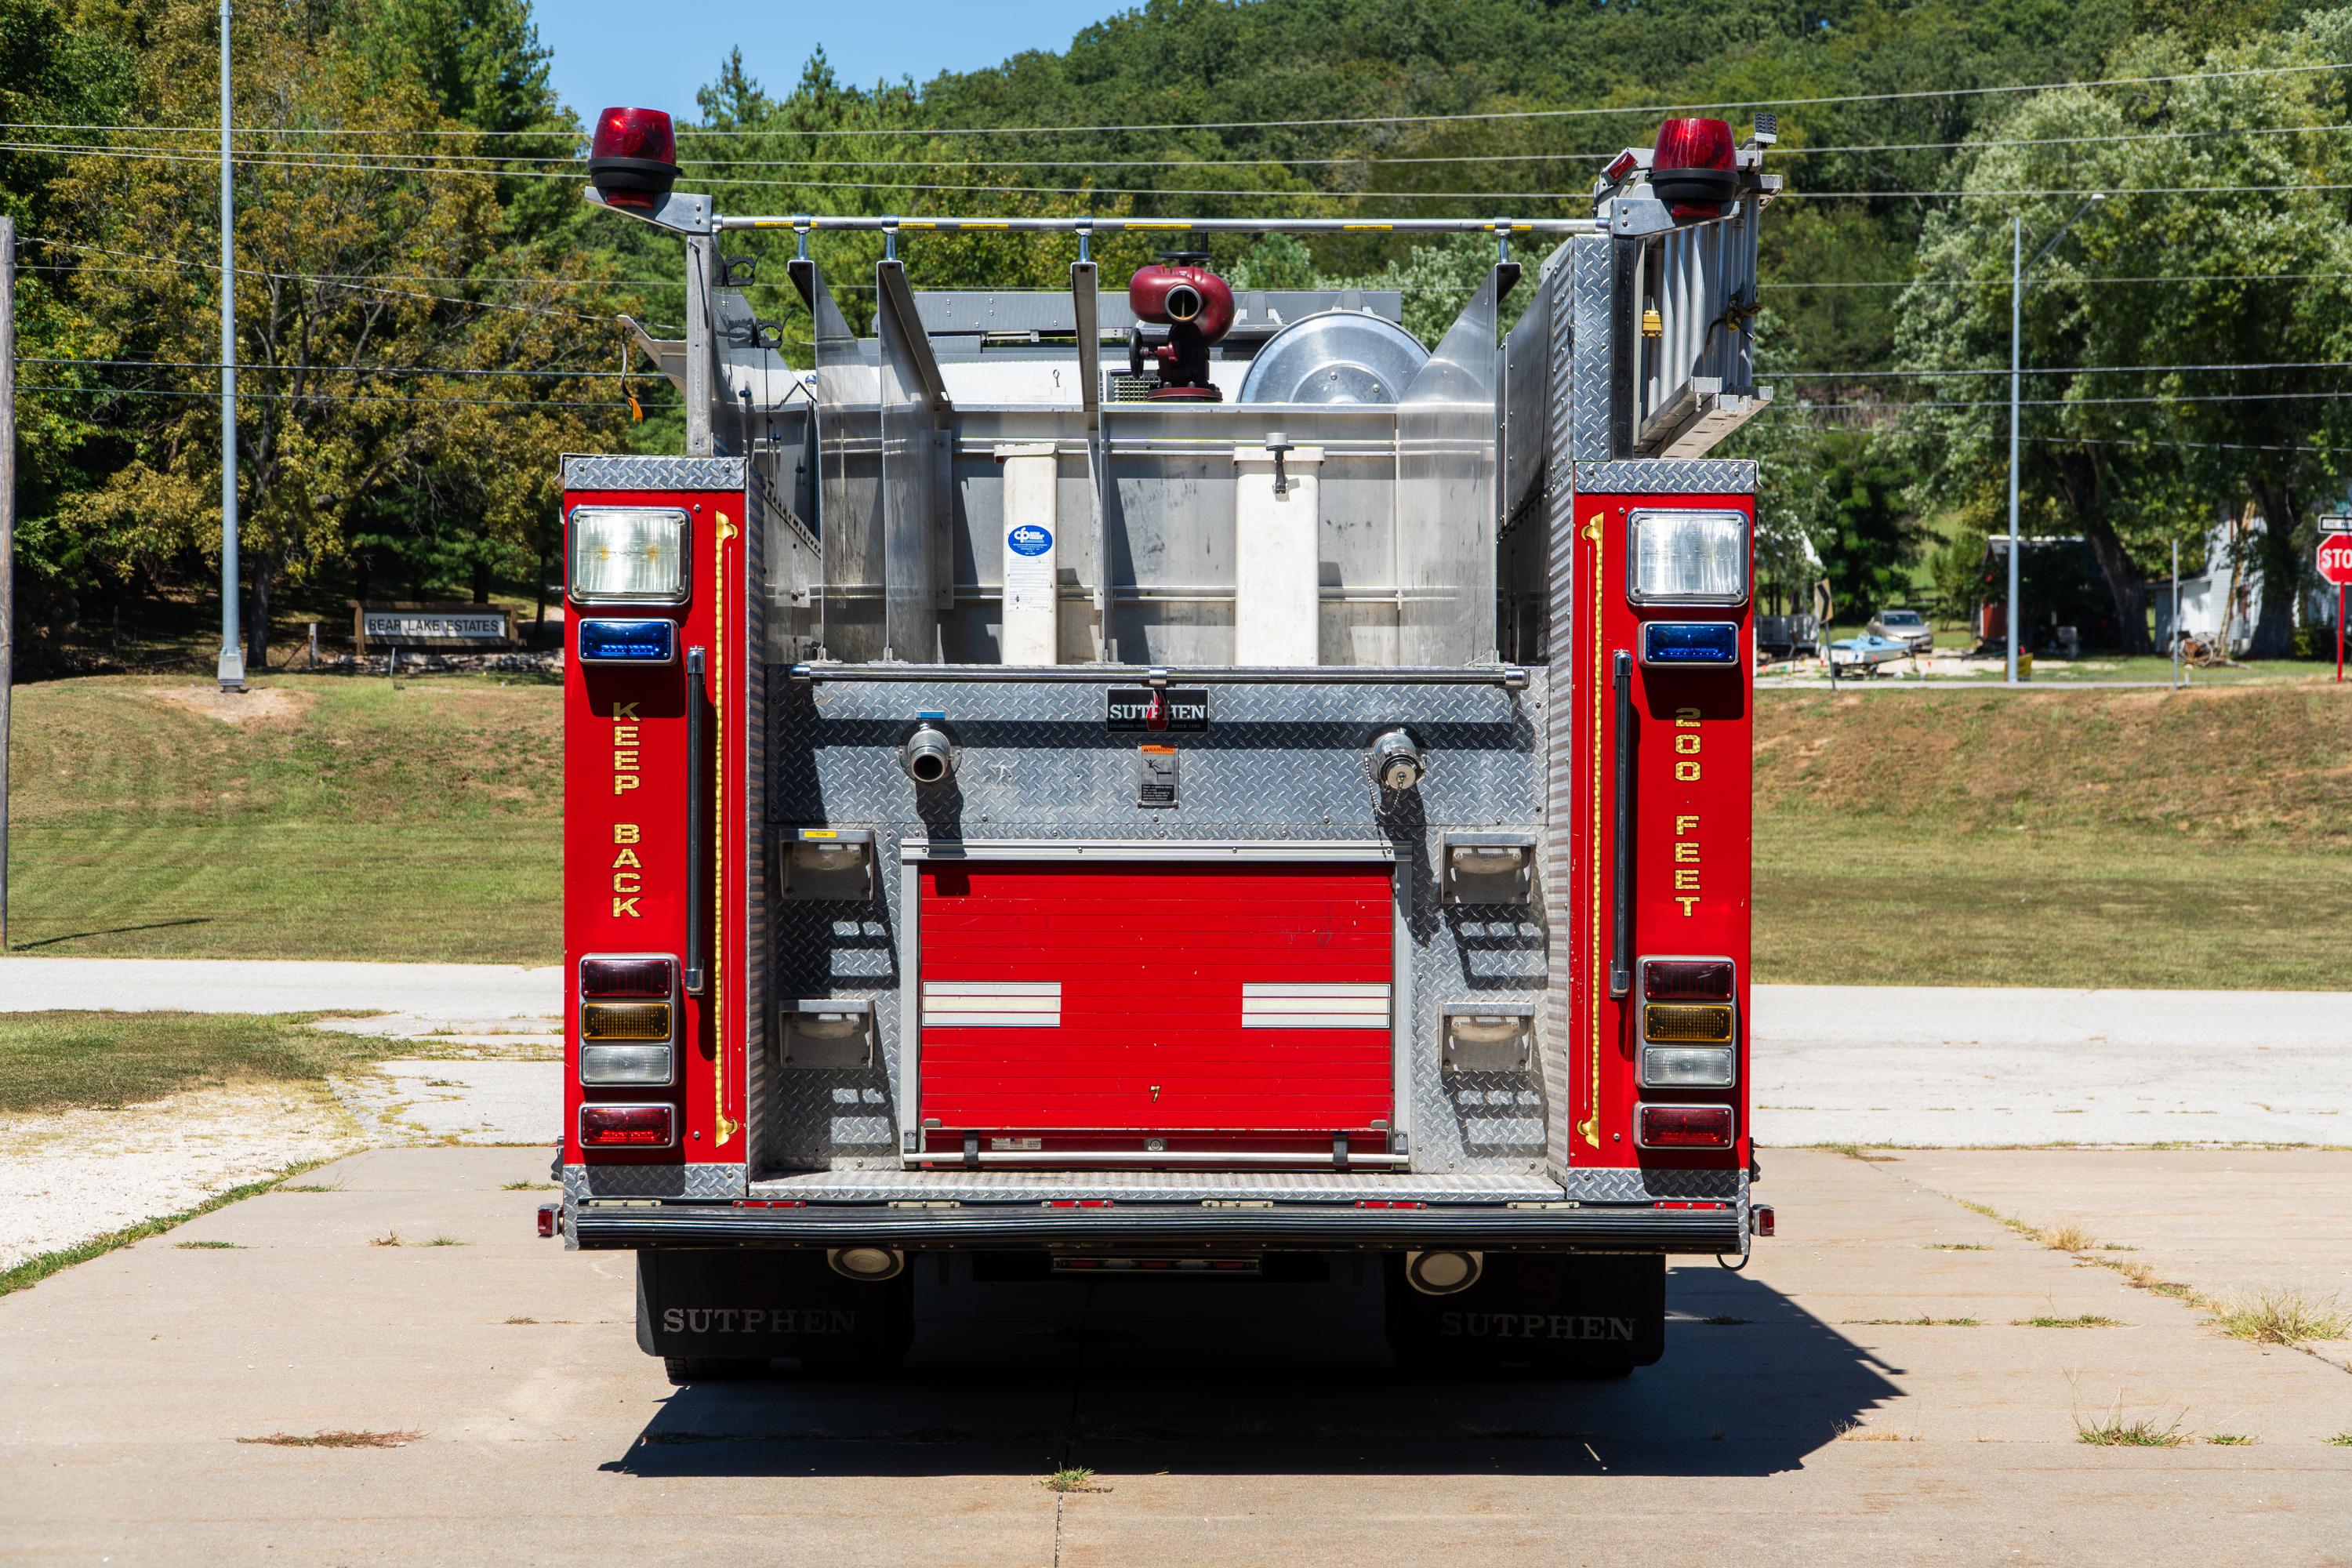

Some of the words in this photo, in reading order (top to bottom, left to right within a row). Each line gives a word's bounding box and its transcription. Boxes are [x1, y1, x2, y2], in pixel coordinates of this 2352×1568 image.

[368, 619, 401, 631] BEAR
[408, 619, 440, 631] LAKE
[446, 619, 499, 632] ESTATES
[1109, 704, 1206, 720] SUTPHEN
[612, 702, 641, 795] KEEP
[1675, 707, 1701, 782] 200
[612, 822, 643, 918] BACK
[1675, 815, 1701, 917] FEET
[1149, 1085, 1161, 1103] 7
[662, 1308, 858, 1334] SUTPHEN
[1441, 1312, 1637, 1341] SUTPHEN
